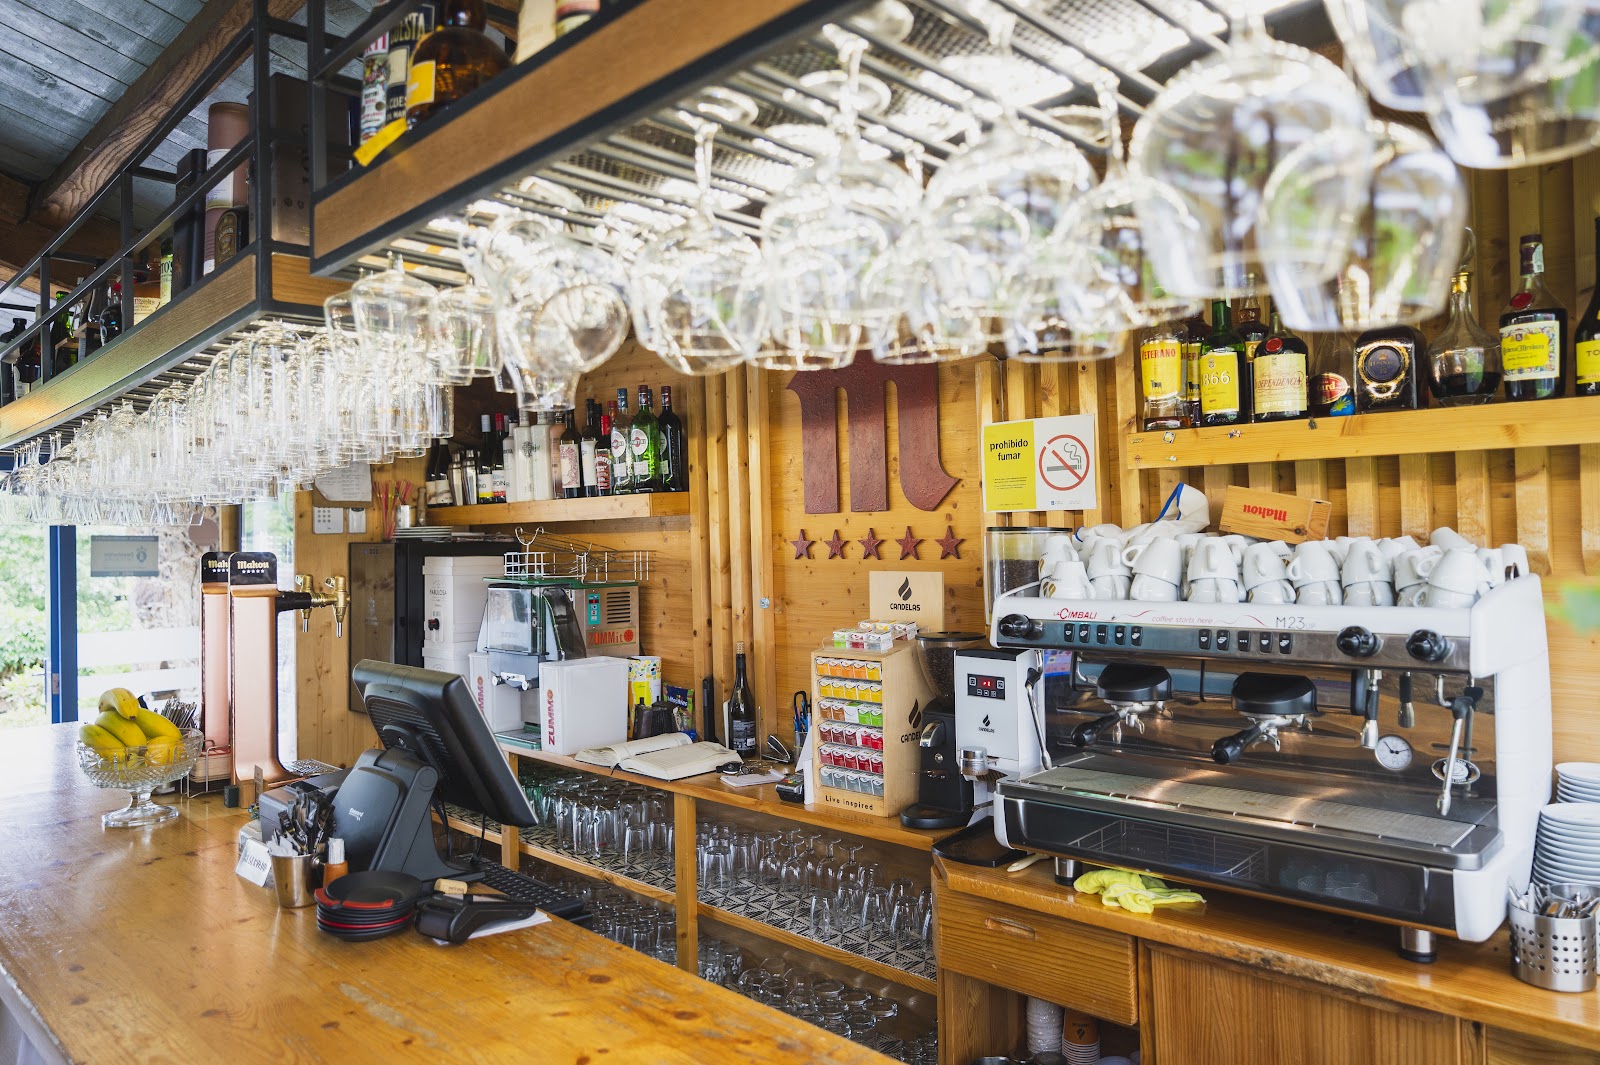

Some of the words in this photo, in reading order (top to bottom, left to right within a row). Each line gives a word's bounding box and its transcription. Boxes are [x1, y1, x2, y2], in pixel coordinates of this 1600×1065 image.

[1141, 348, 1176, 361] VETERANO
[989, 439, 1029, 452] prohibido
[997, 451, 1021, 461] fumar
[890, 602, 921, 611] CANDELAS
[1151, 615, 1174, 623] coffee
[1176, 616, 1195, 624] starts
[1197, 616, 1213, 625] here
[1276, 617, 1305, 630] M23
[825, 794, 840, 804] Live
[842, 797, 874, 811] inspired
